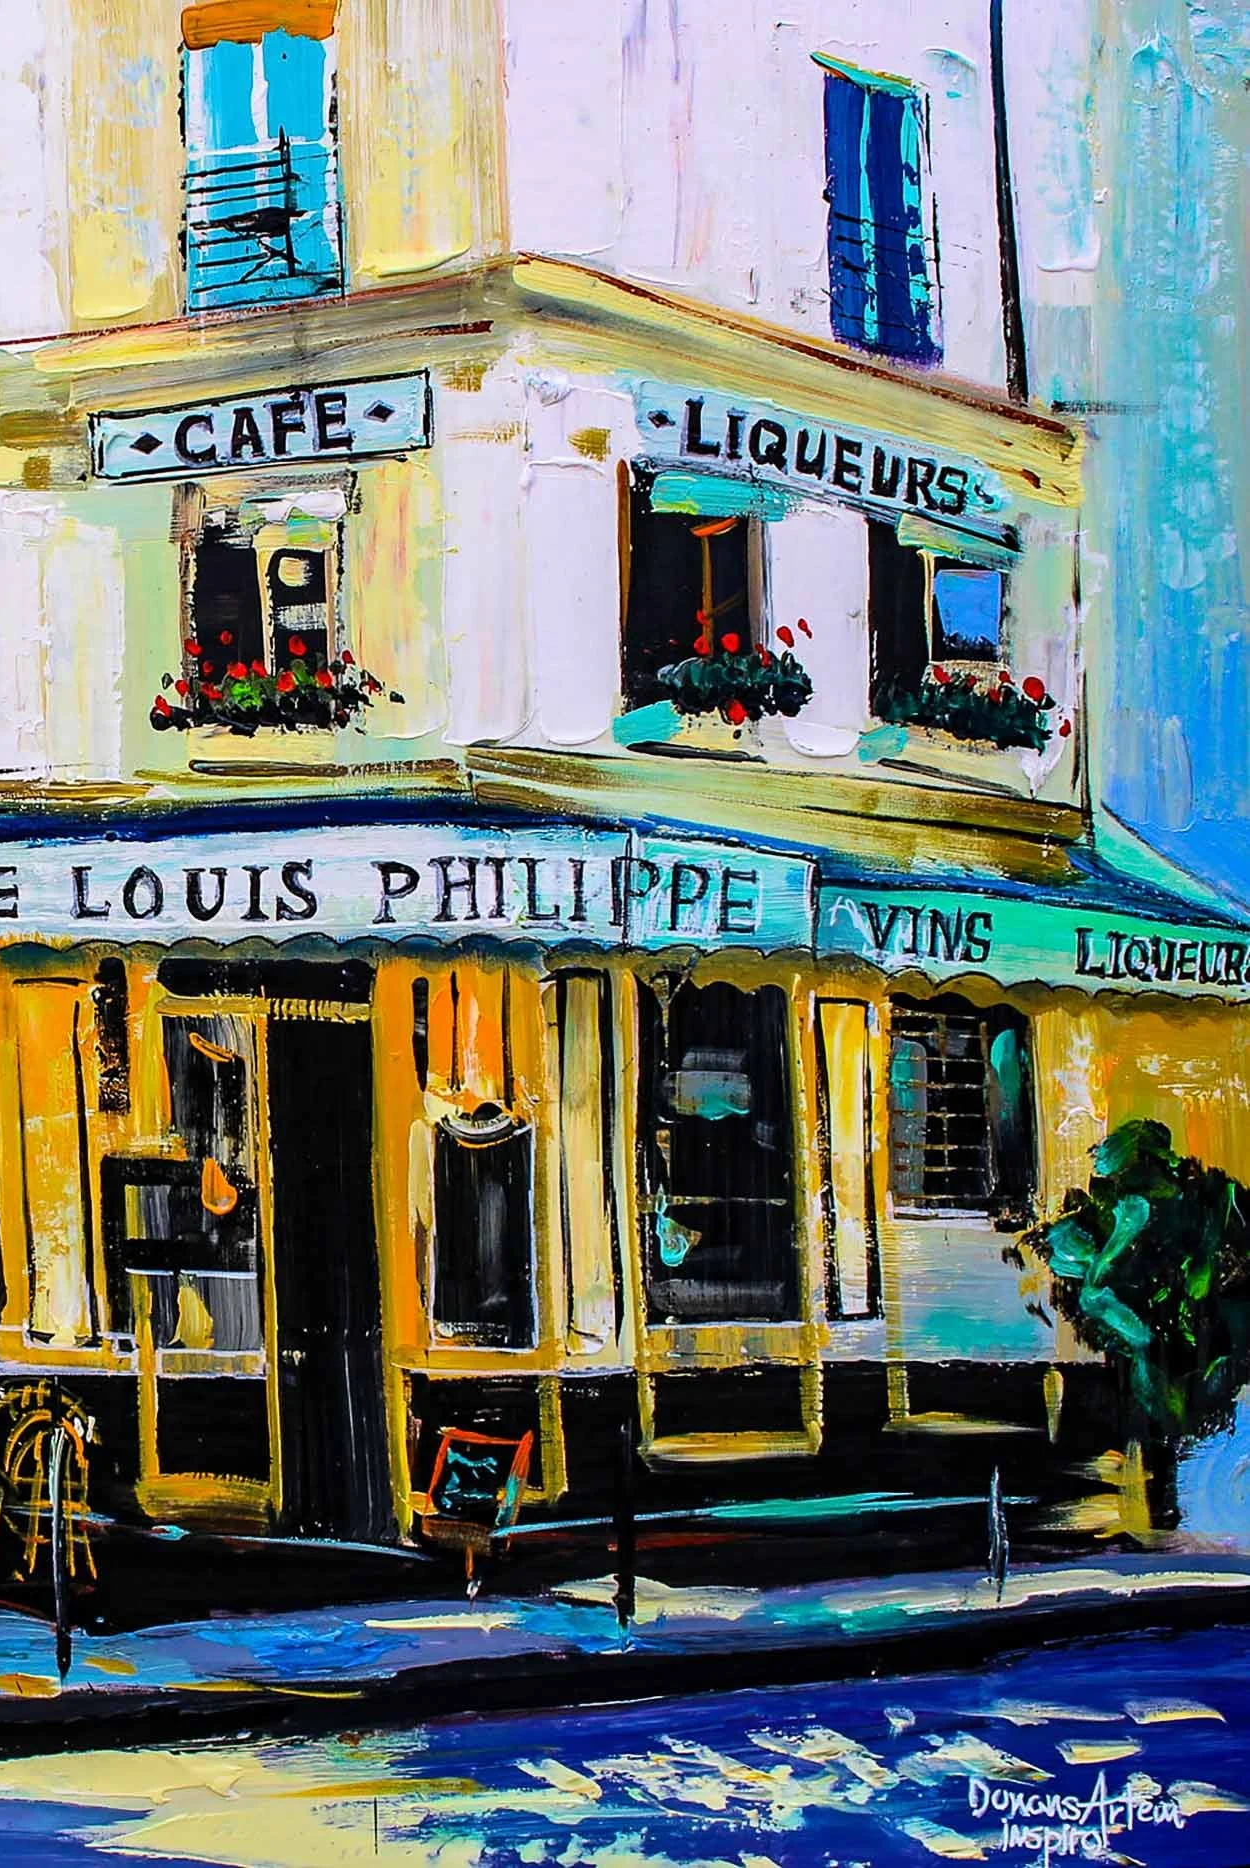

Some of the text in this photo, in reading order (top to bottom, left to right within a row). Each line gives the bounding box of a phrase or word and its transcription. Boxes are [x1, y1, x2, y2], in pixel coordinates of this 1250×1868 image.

[685, 396, 967, 515] LIQUEURS
[71, 858, 319, 922] LOUIS
[371, 856, 757, 933] PHILIPPE
[861, 902, 993, 962] VINS
